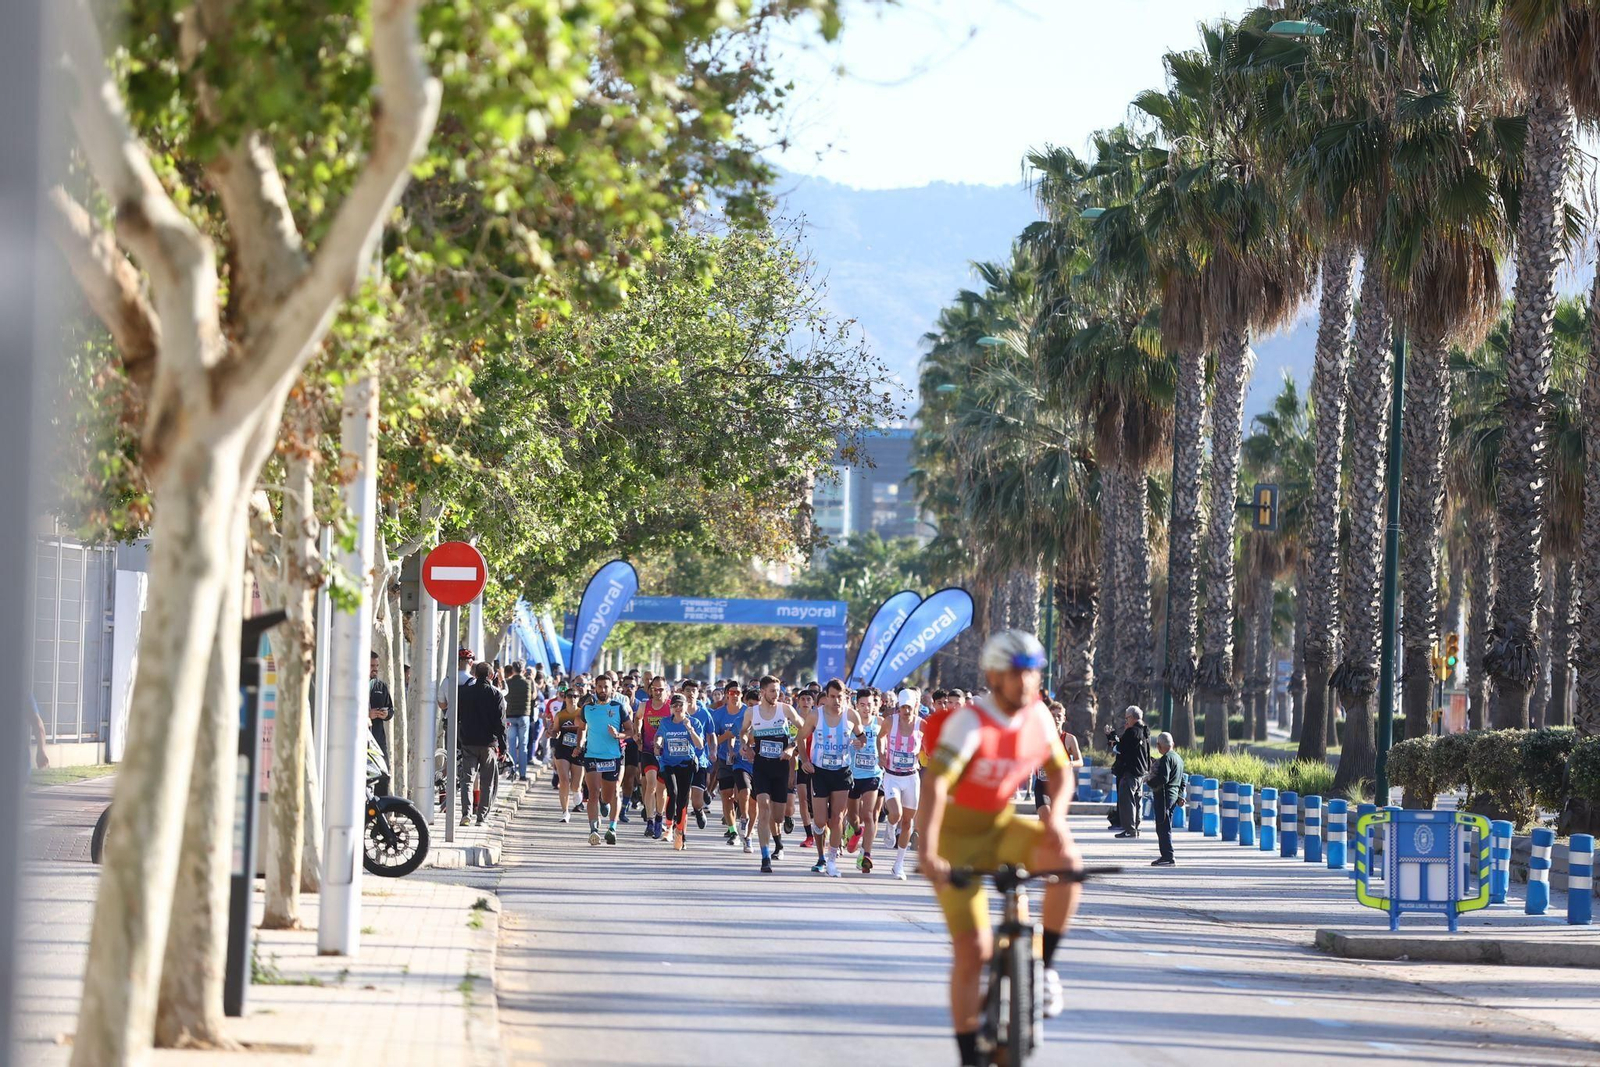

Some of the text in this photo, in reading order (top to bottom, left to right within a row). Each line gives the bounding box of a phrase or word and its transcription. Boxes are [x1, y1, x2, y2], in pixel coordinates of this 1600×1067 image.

[579, 579, 624, 652] mayoral
[777, 605, 837, 620] mayoral
[860, 608, 908, 676] mayoral
[889, 606, 957, 672] mayoral
